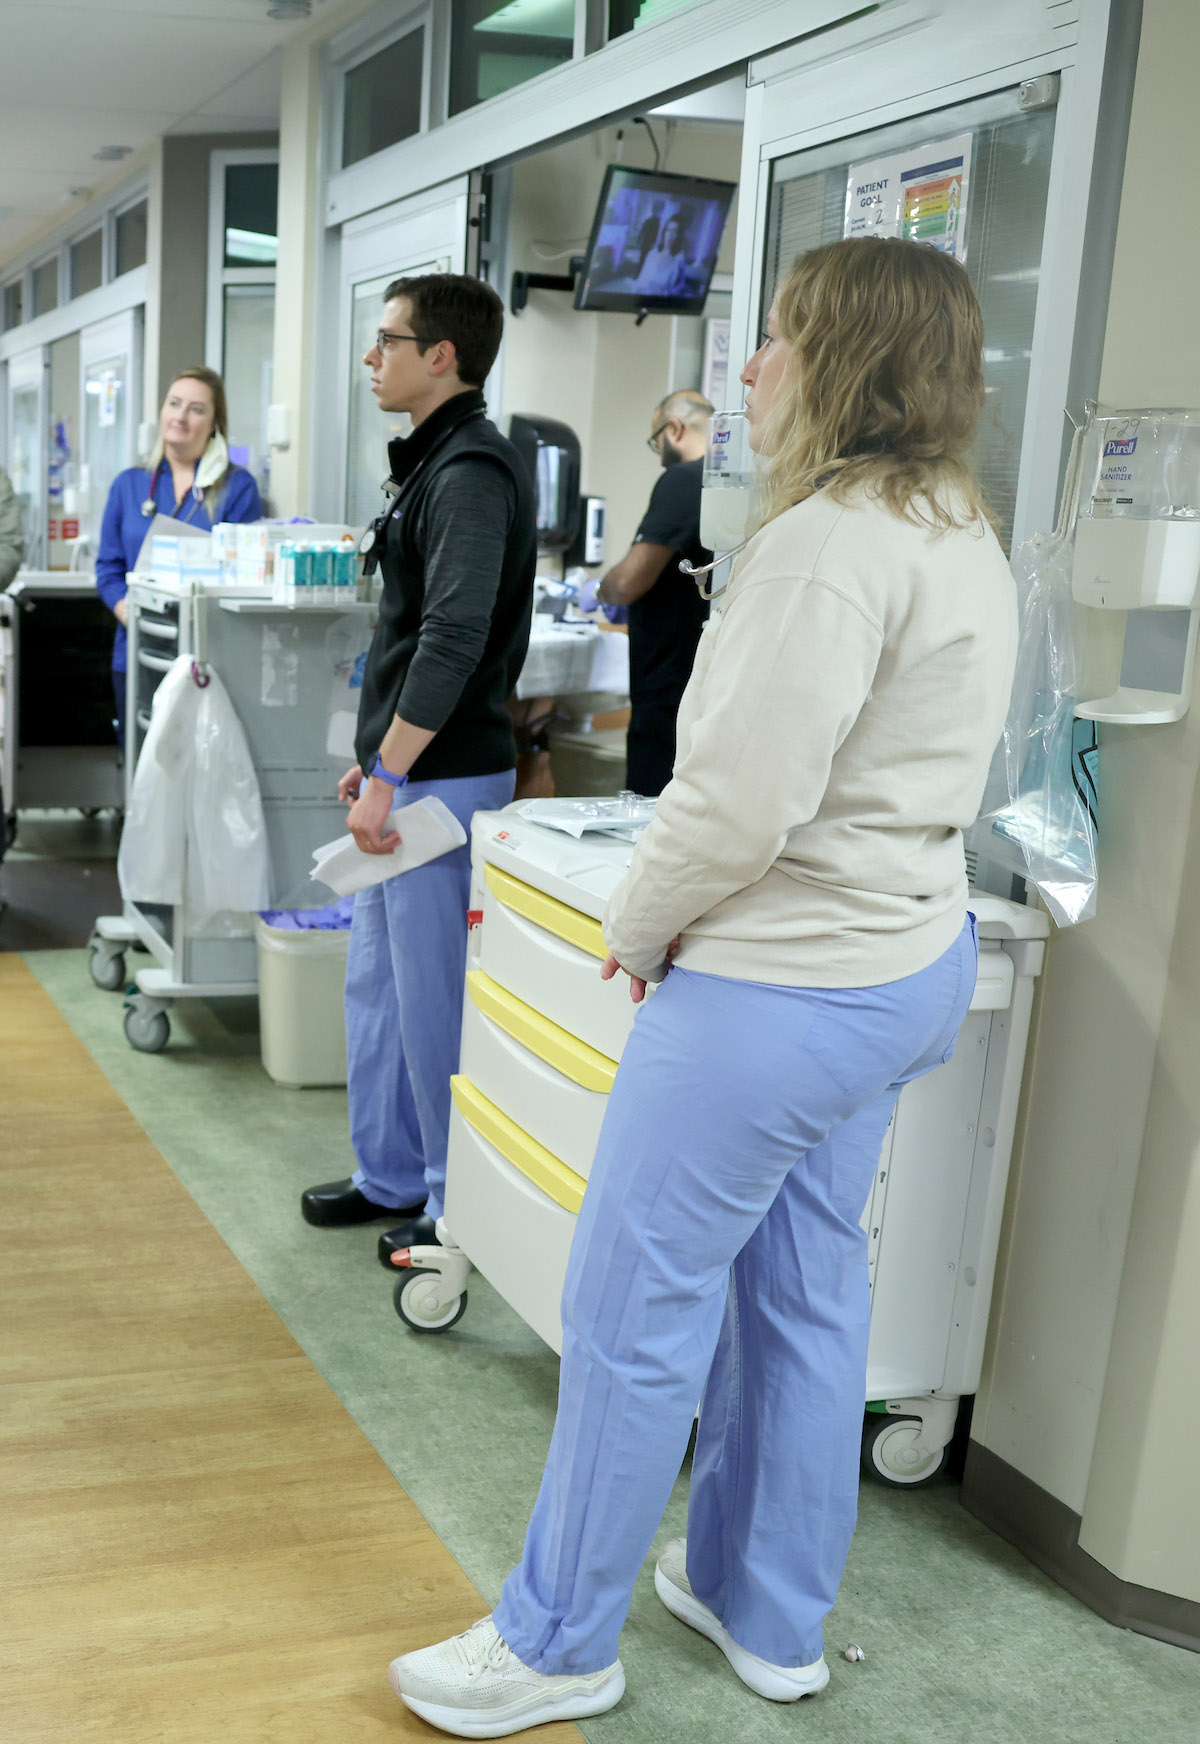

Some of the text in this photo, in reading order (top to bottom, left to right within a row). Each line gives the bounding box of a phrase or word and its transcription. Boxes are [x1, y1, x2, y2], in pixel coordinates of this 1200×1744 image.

[856, 179, 889, 196] PATIENT
[860, 194, 882, 208] GOAL
[875, 208, 883, 224] 2
[1106, 440, 1135, 454] Purell
[1107, 465, 1128, 473] HAND
